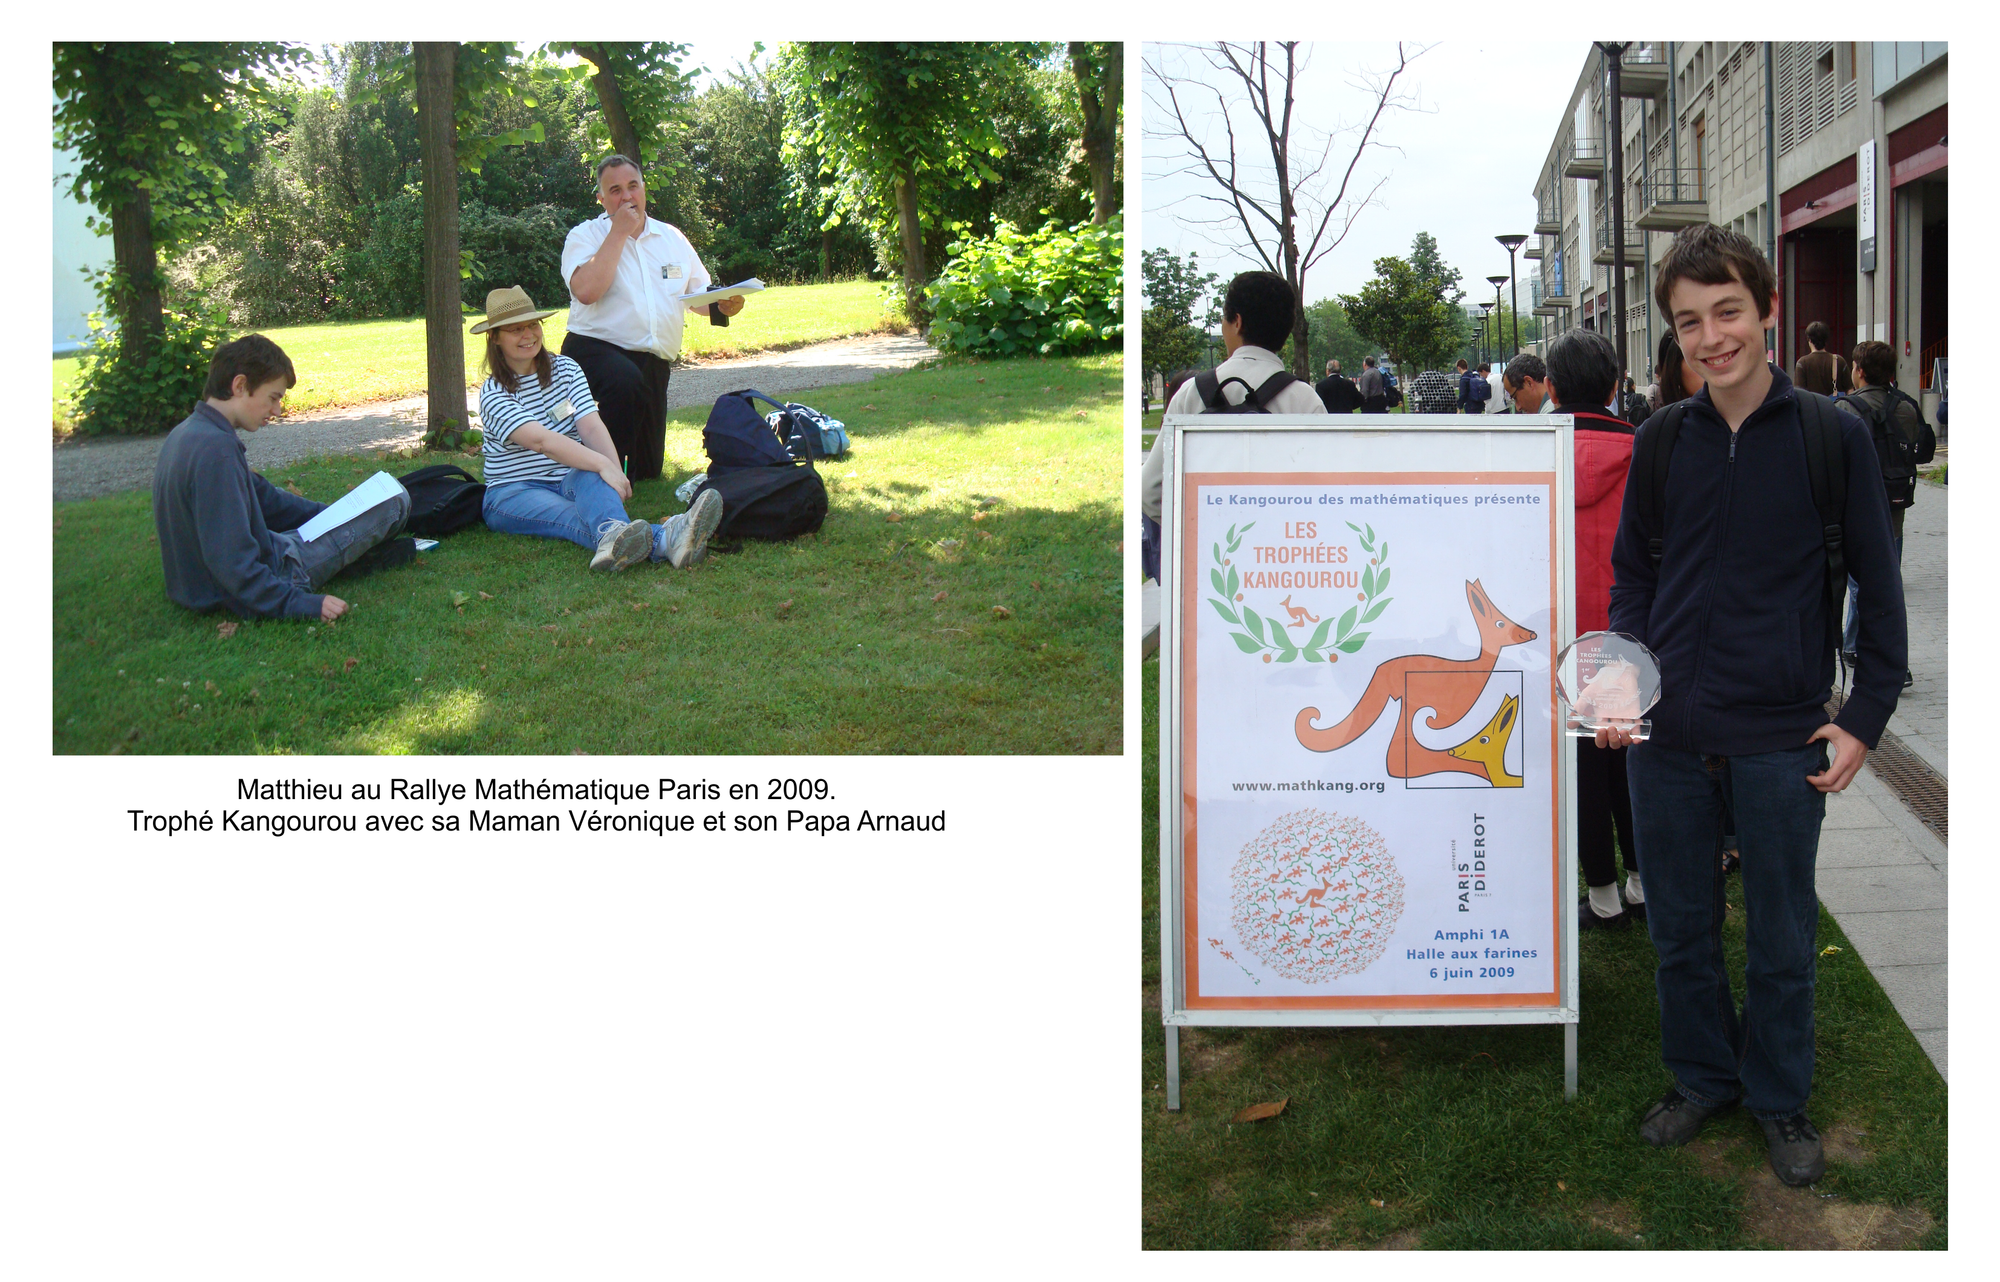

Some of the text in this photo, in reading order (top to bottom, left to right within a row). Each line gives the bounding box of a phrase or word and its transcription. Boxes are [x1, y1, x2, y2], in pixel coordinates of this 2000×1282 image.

[1206, 493, 1541, 508] Le Kangourou des mathématiques présente
[1285, 521, 1317, 539] LES
[1253, 541, 1348, 564] TROPHÉES
[1243, 570, 1358, 589] KANGOUROU
[1232, 779, 1386, 794] www.mathkang.org
[1474, 813, 1486, 891] DIDEROT
[1458, 863, 1470, 912] PARIS
[1434, 929, 1510, 943] Amphi 1A
[1406, 947, 1538, 960] Halle aux farines
[1429, 966, 1515, 982] 6 juin 2009
